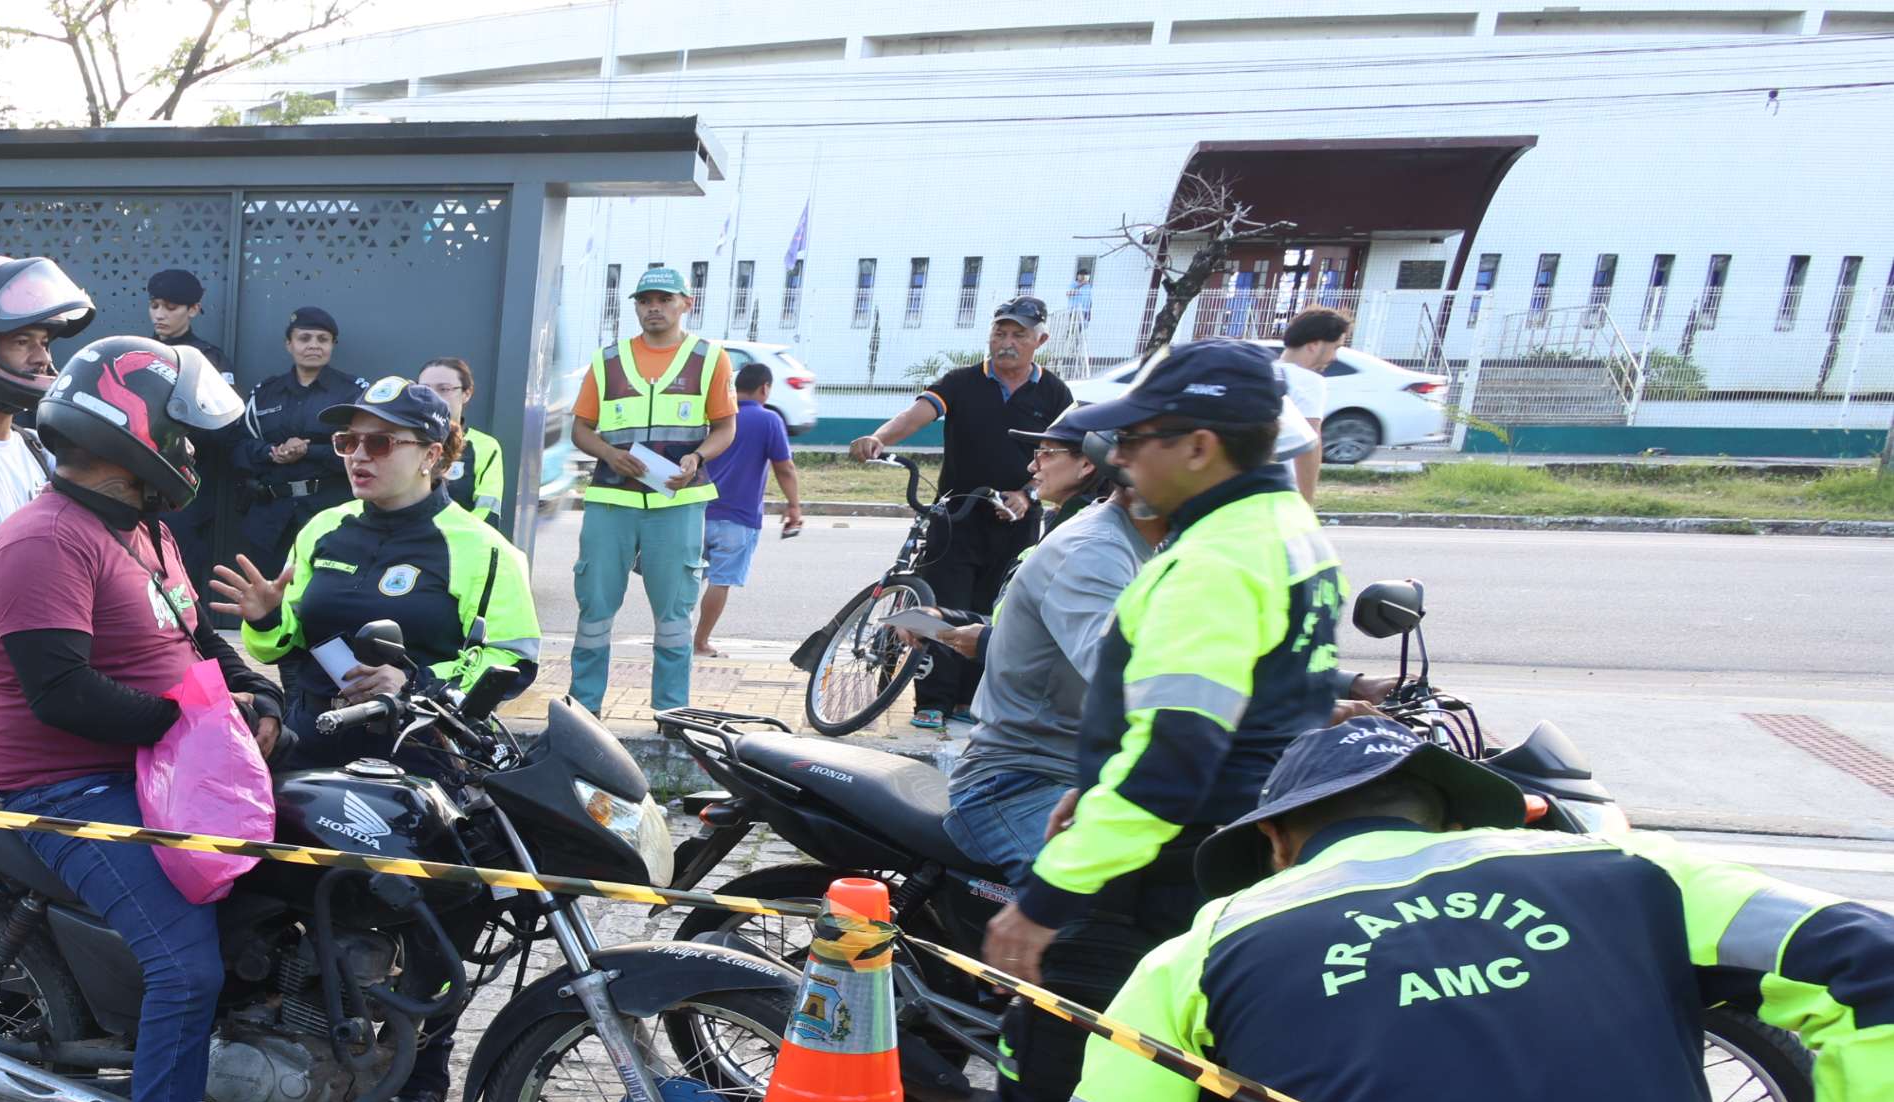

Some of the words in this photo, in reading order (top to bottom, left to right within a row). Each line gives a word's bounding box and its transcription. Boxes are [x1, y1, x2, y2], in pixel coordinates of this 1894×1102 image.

[1364, 743, 1412, 756] AMC
[809, 765, 854, 783] HONDA
[316, 815, 381, 851] HONDA
[1322, 892, 1570, 997] TRÂNSITO
[1399, 957, 1530, 1007] AMC
